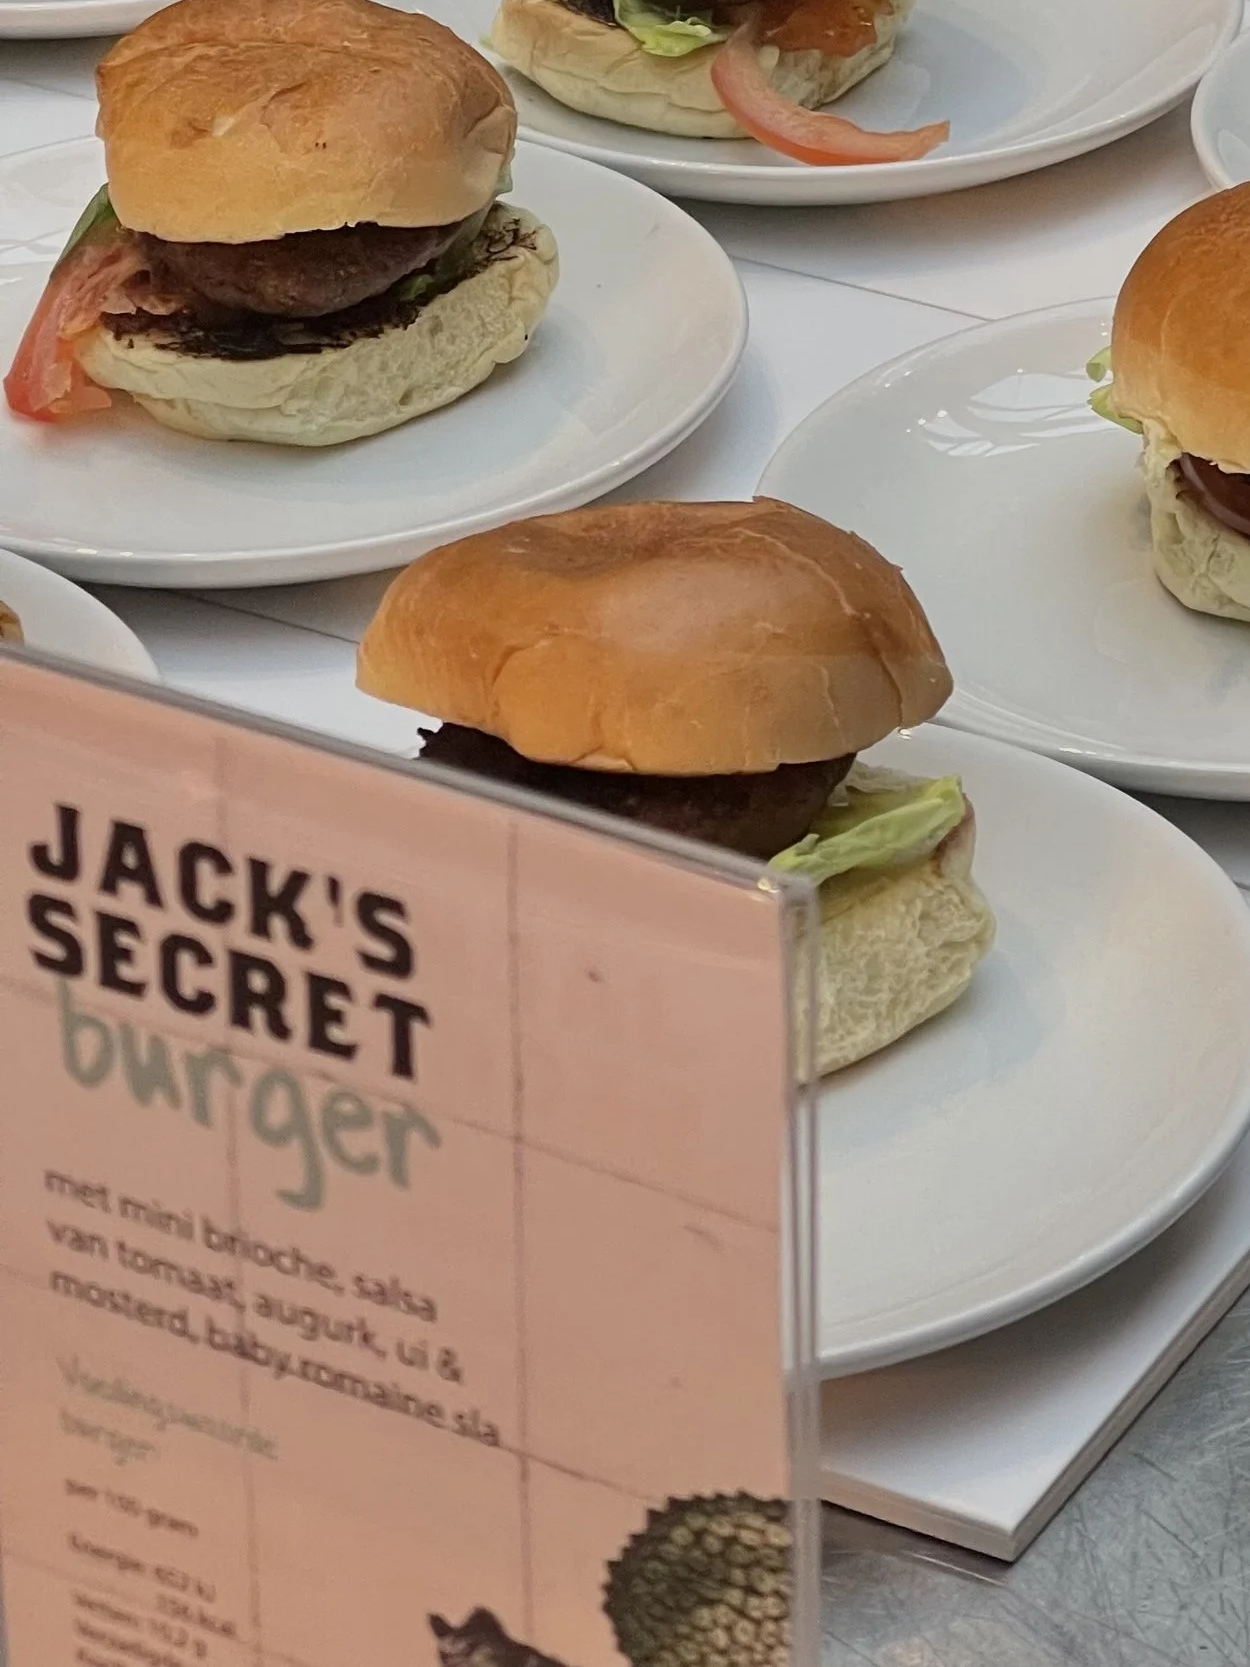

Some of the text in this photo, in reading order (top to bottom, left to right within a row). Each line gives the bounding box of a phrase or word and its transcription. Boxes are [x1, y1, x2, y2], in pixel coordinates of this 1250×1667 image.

[28, 801, 416, 981] JACK'S
[27, 892, 434, 1083] SECRET
[57, 979, 443, 1212] burger
[44, 1169, 438, 1323] met mini brioche, salsa
[46, 1219, 464, 1385] van tomaat, augurk, ui &
[49, 1270, 198, 1345] mosterd,
[451, 1405, 502, 1449] sla
